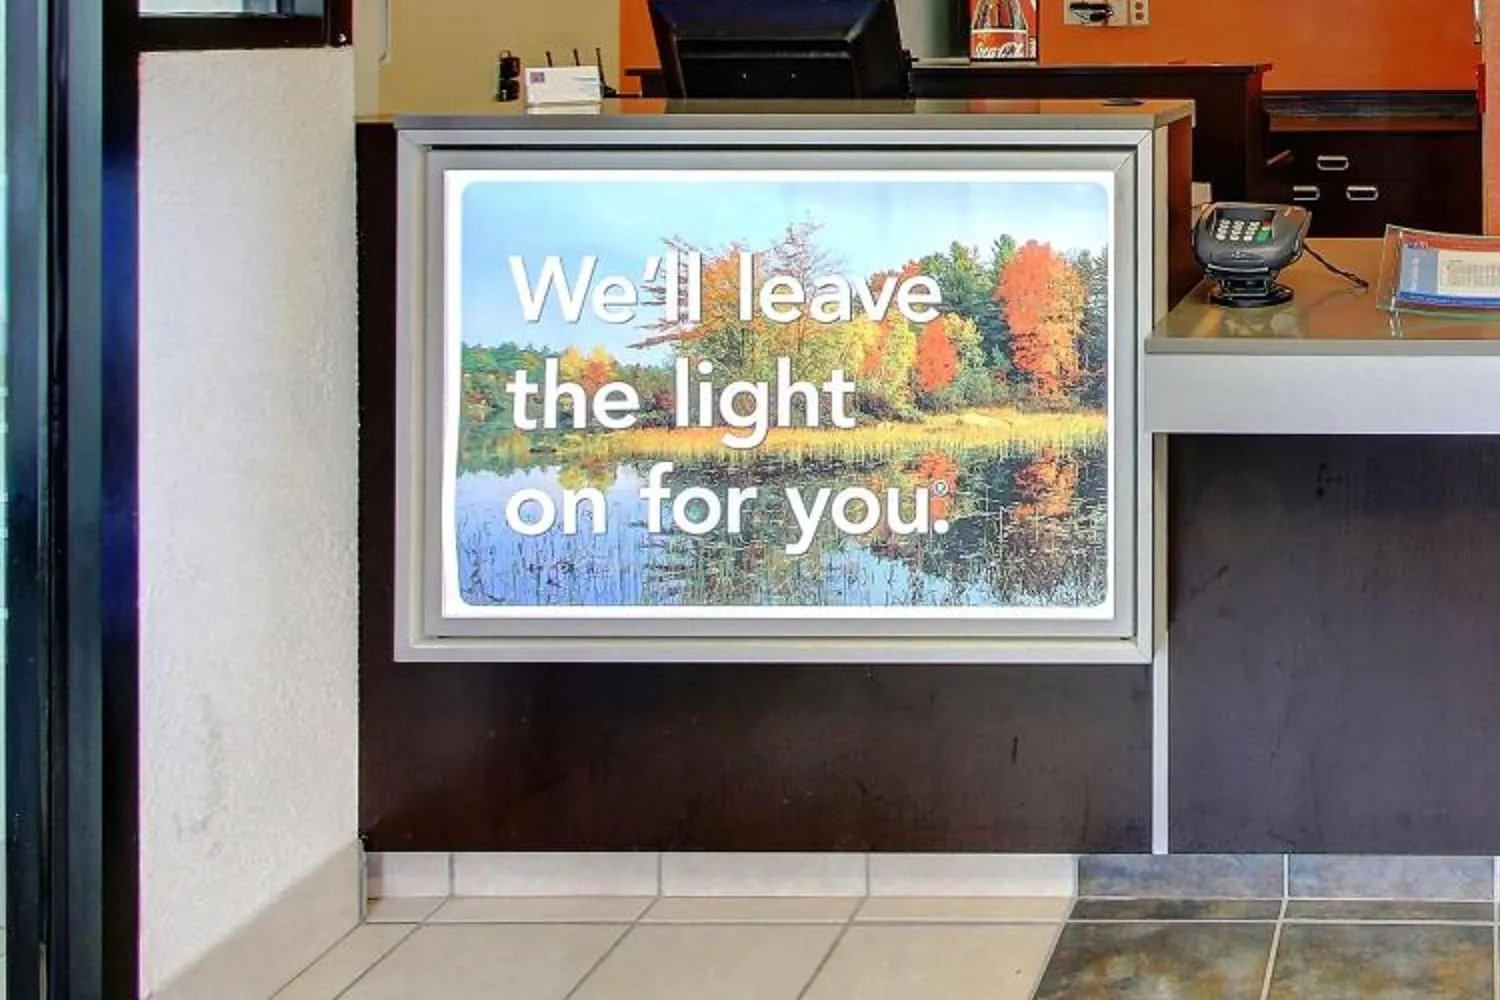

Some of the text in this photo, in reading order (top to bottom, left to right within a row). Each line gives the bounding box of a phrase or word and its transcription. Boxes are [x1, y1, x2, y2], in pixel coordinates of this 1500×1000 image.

[508, 251, 943, 324] We'll leave
[505, 357, 856, 449] the light
[505, 486, 608, 536] on
[640, 462, 758, 535] for
